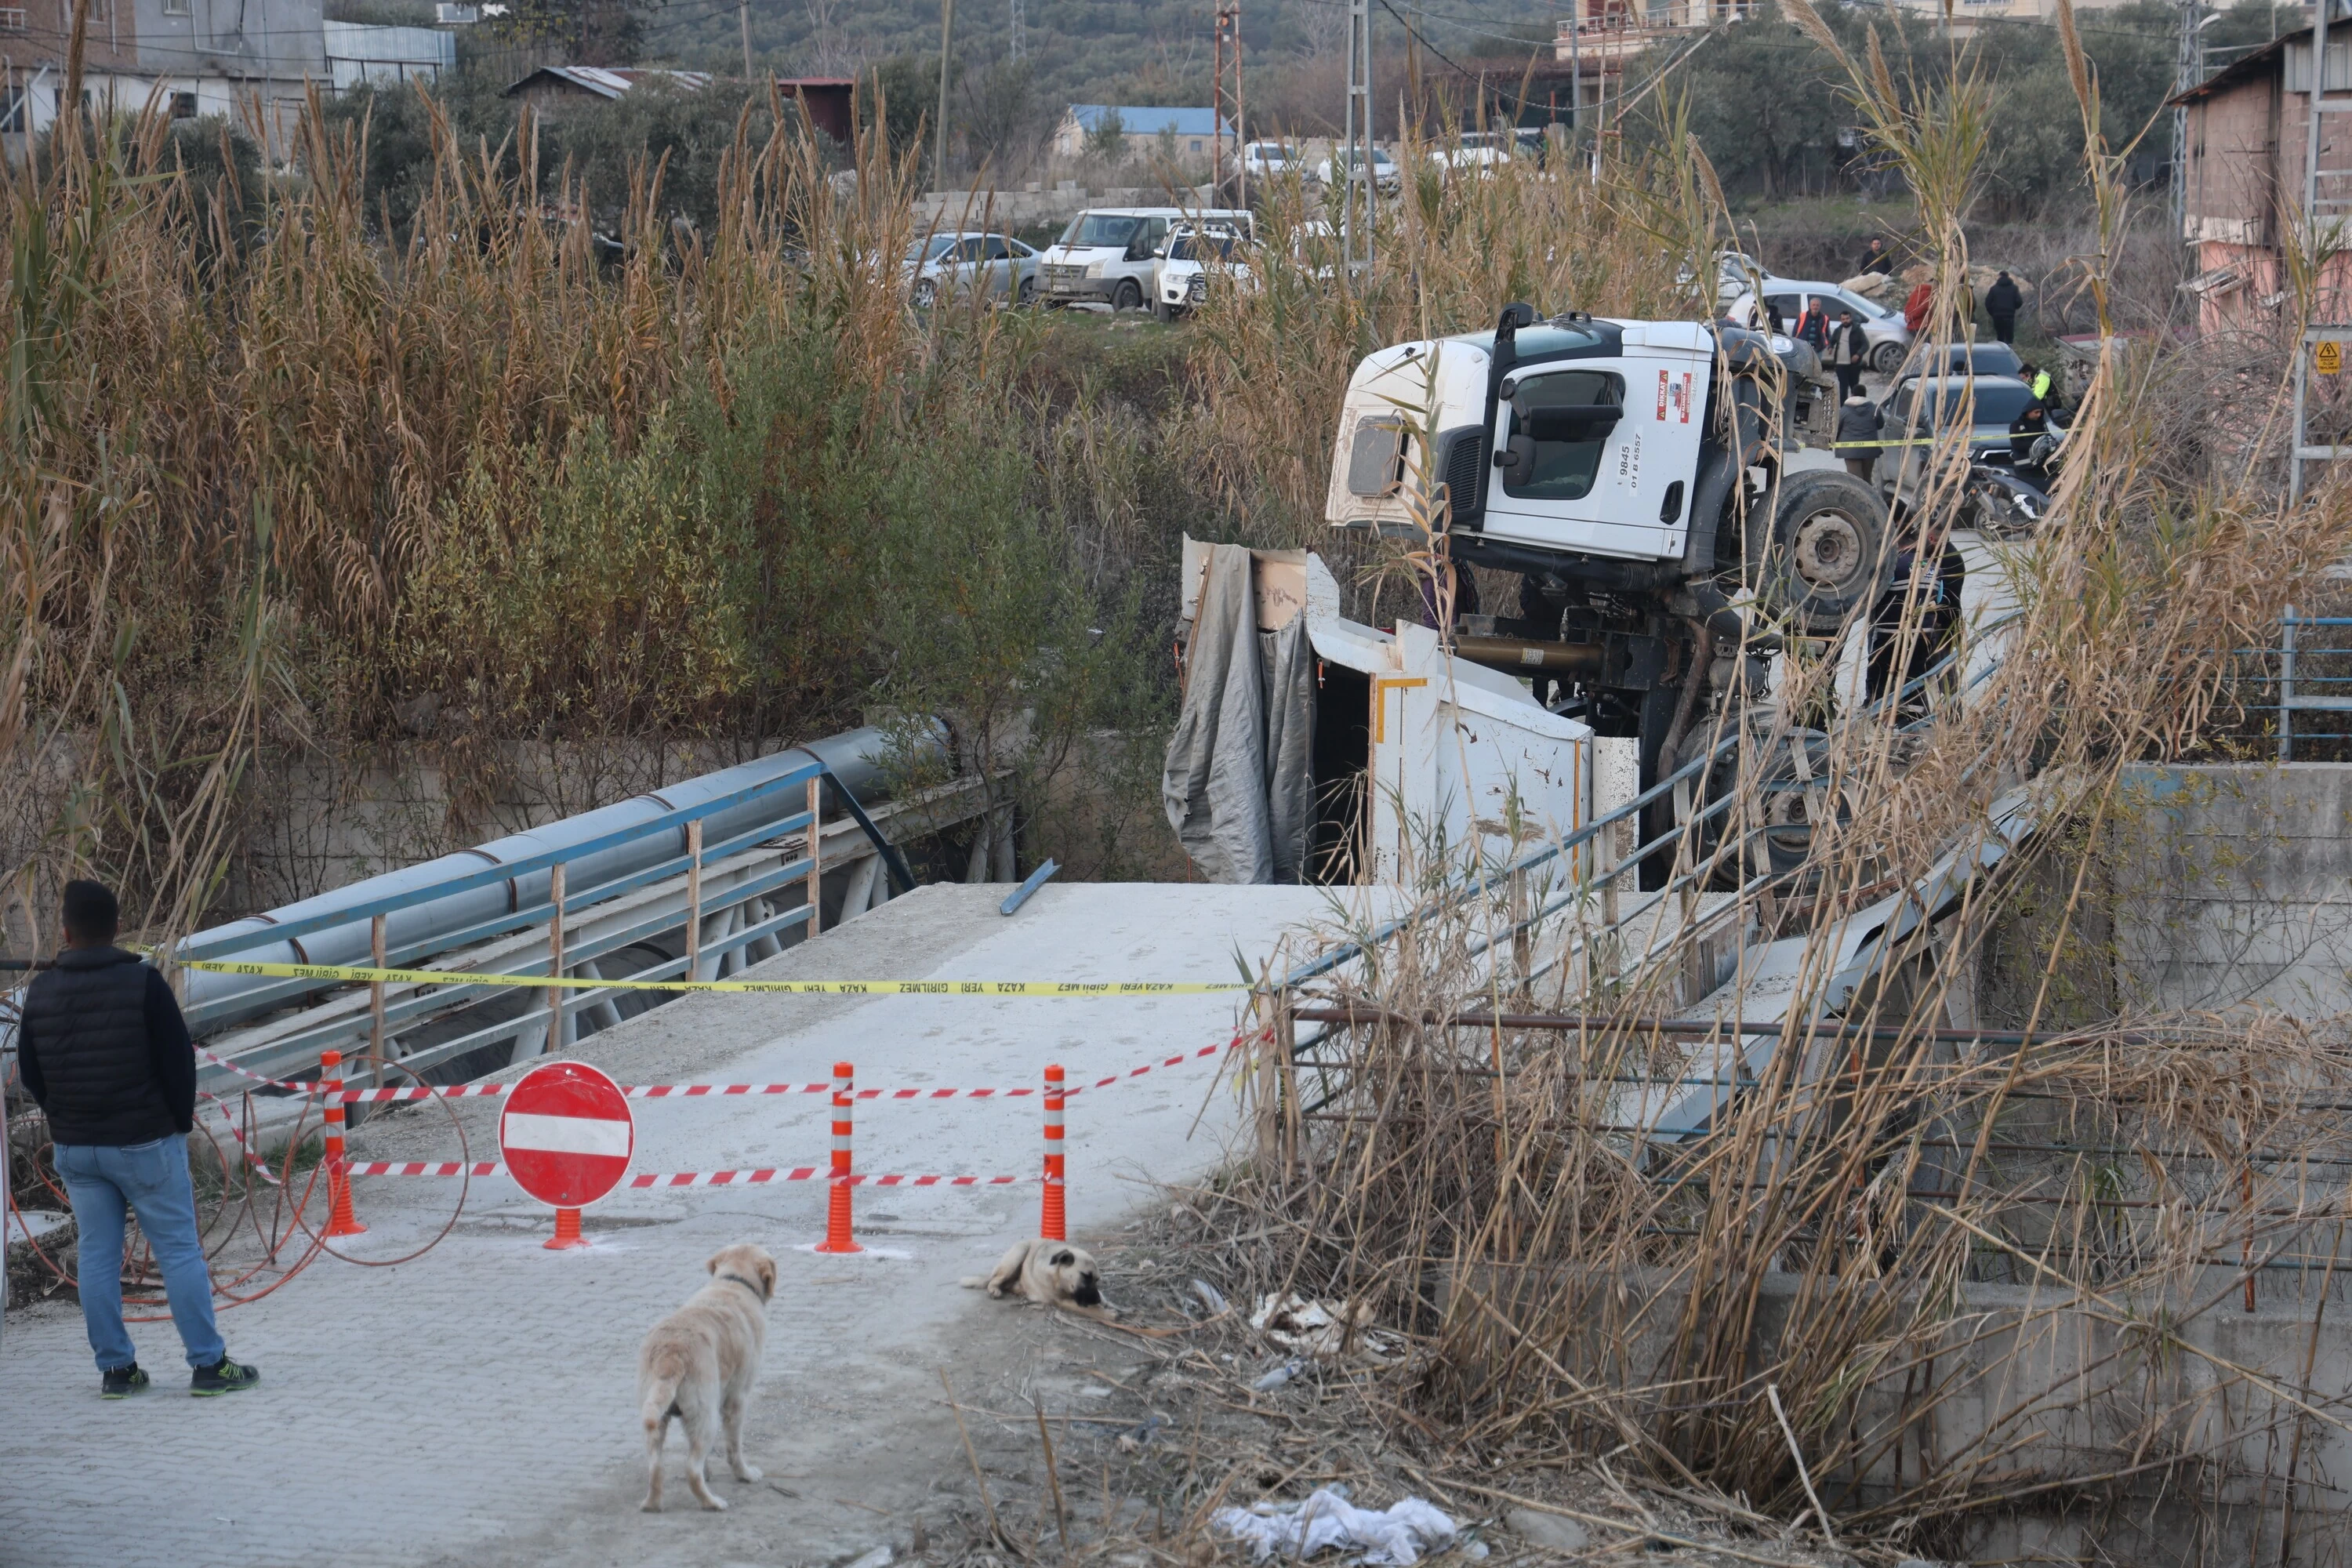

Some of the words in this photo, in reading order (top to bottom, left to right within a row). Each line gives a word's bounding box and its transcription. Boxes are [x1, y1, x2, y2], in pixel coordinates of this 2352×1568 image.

[1620, 445, 1630, 476] 9845
[1632, 463, 1639, 472] B
[1631, 475, 1637, 488] 01
[840, 984, 867, 993] KAZA
[961, 982, 984, 994] YERİ
[997, 982, 1025, 993] KAZA
